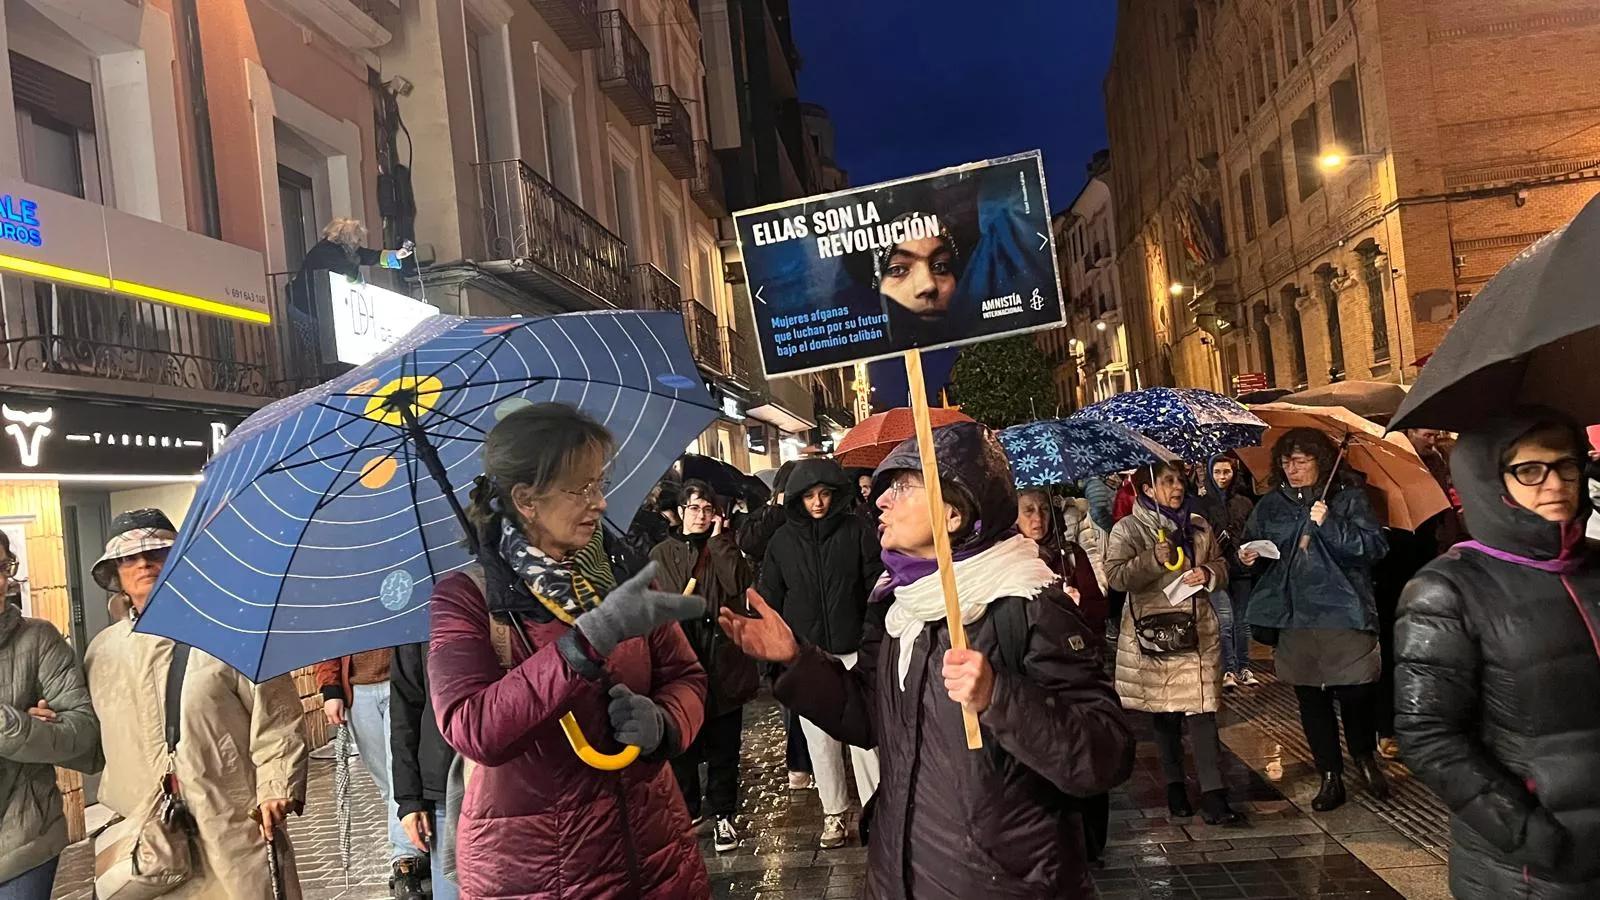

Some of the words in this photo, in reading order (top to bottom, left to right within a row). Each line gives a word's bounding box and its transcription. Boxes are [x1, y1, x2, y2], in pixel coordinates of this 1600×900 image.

[752, 215, 809, 247] ELLAS
[812, 205, 855, 235] SON
[856, 201, 881, 226] LA
[817, 211, 940, 259] REVOLUCIÓN
[982, 292, 1023, 311] AMNISTÍA
[771, 313, 810, 329] Mujeres
[811, 306, 849, 322] afganas
[774, 332, 793, 345] que
[793, 326, 826, 340] luchan
[826, 321, 843, 335] por
[845, 319, 857, 330] su
[858, 313, 889, 327] futuro
[776, 344, 798, 357] bajo
[799, 340, 808, 353] el
[810, 335, 848, 351] dominio
[848, 328, 883, 343] talibán
